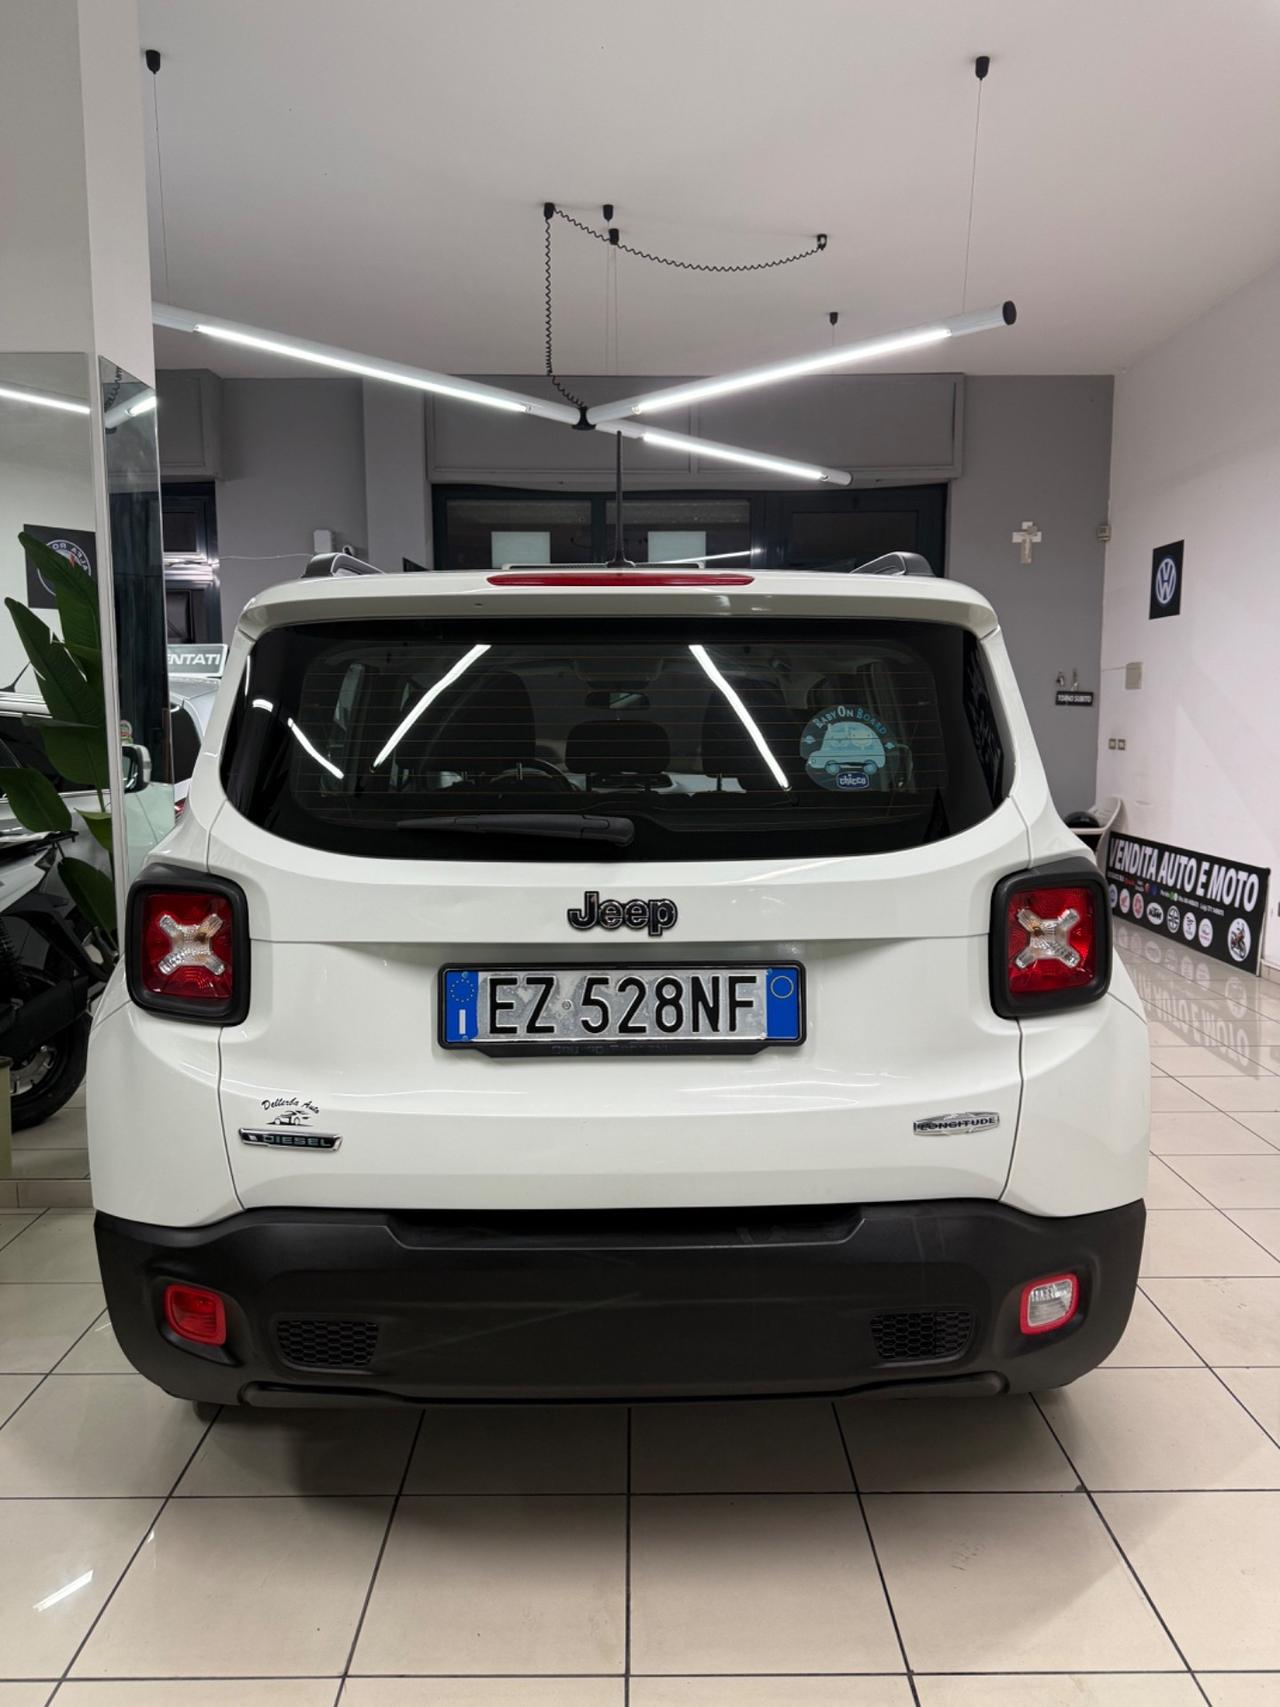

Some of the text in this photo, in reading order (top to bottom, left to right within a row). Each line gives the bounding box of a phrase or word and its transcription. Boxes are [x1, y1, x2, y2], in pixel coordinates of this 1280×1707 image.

[839, 773, 866, 786] chicco
[1109, 837, 1260, 913] VENDITA AUTO E MOTO
[567, 891, 678, 937] Jeep
[488, 975, 556, 1035] EZ
[262, 1134, 332, 1147] DIESEL
